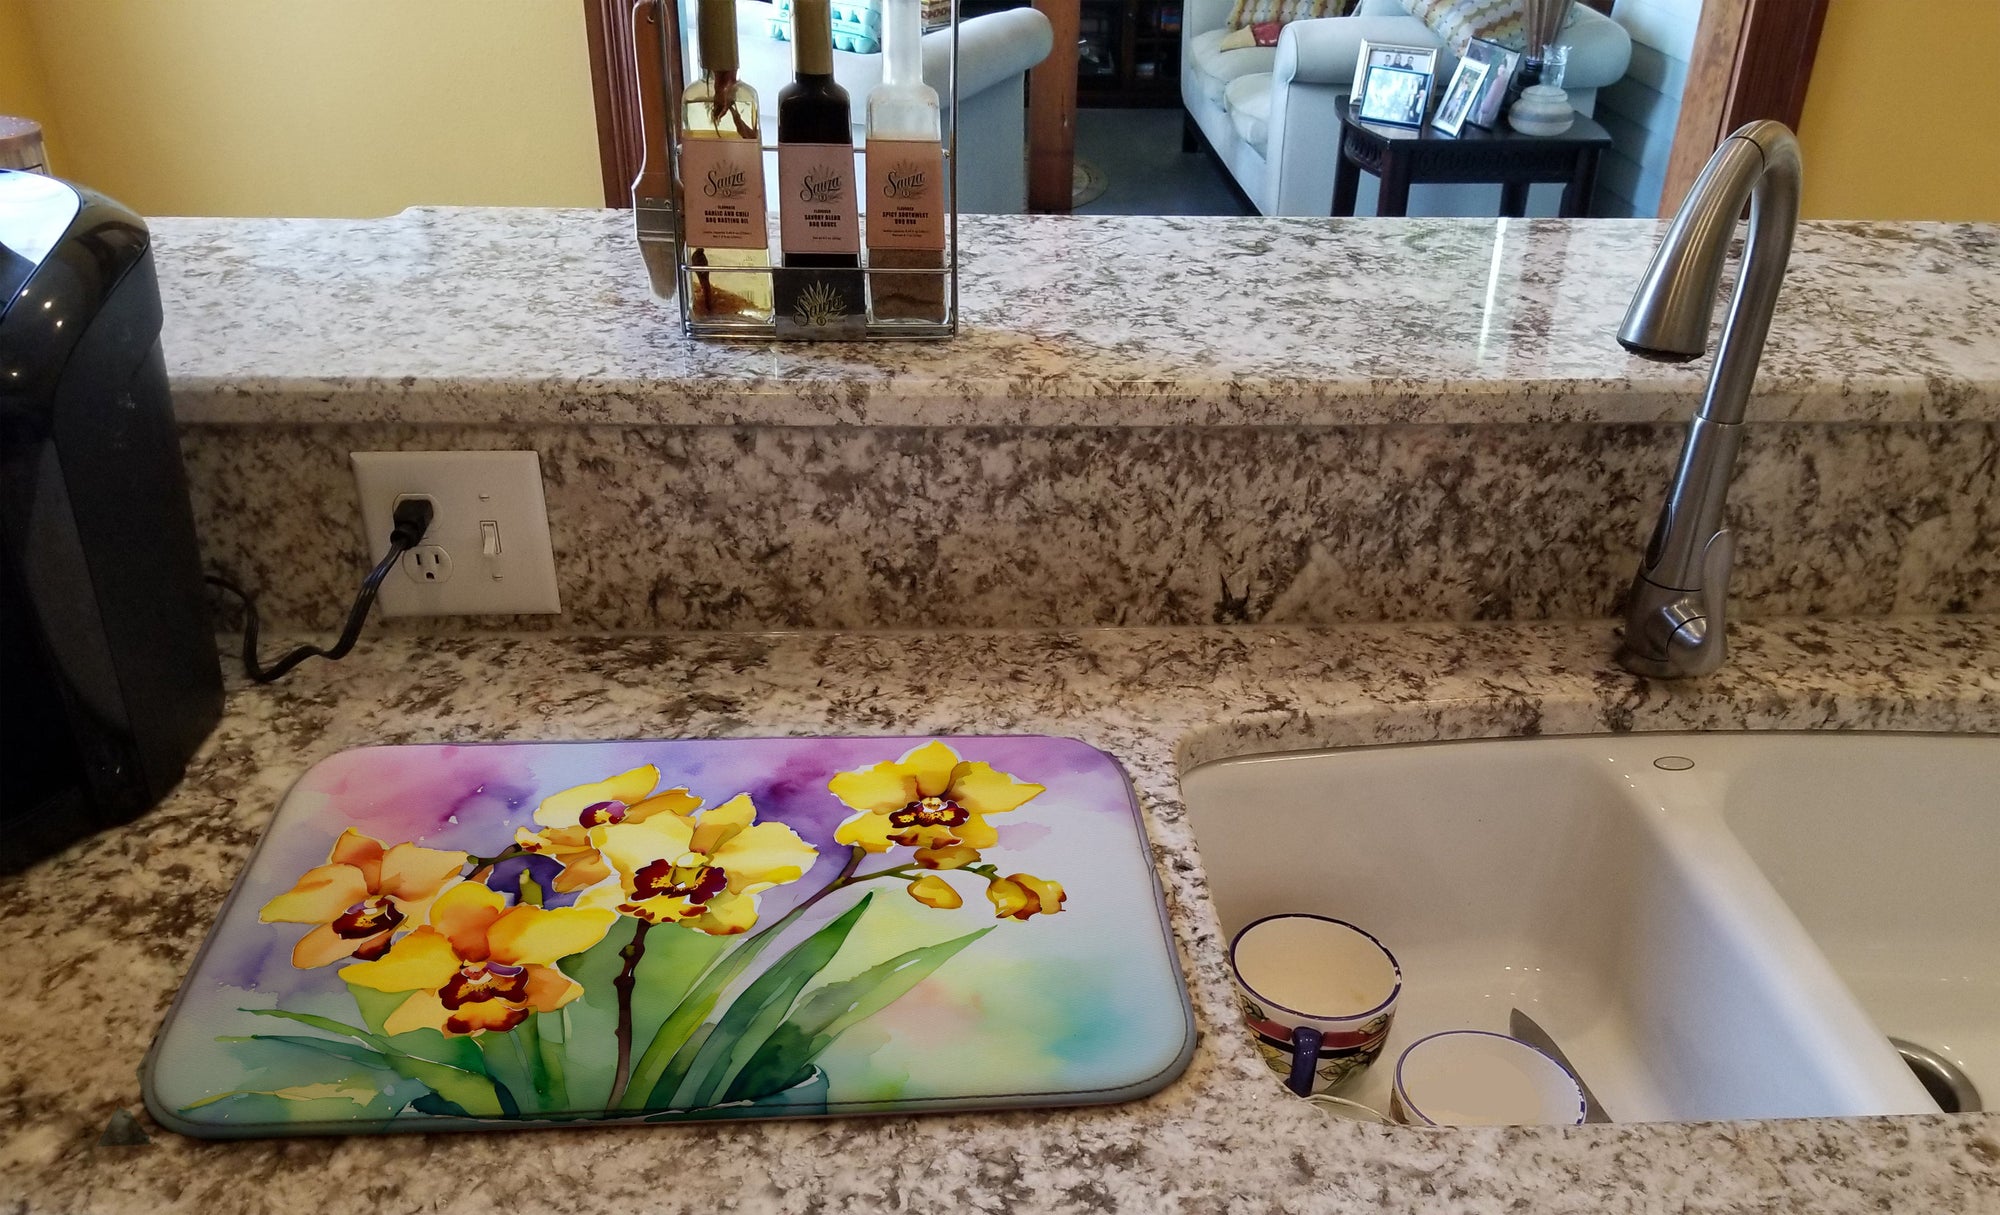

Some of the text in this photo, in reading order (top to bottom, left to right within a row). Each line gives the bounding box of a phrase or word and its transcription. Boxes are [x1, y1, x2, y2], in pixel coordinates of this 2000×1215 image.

[703, 169, 745, 197] Sauza
[800, 175, 841, 202] Sauza
[884, 170, 925, 198] Sauza
